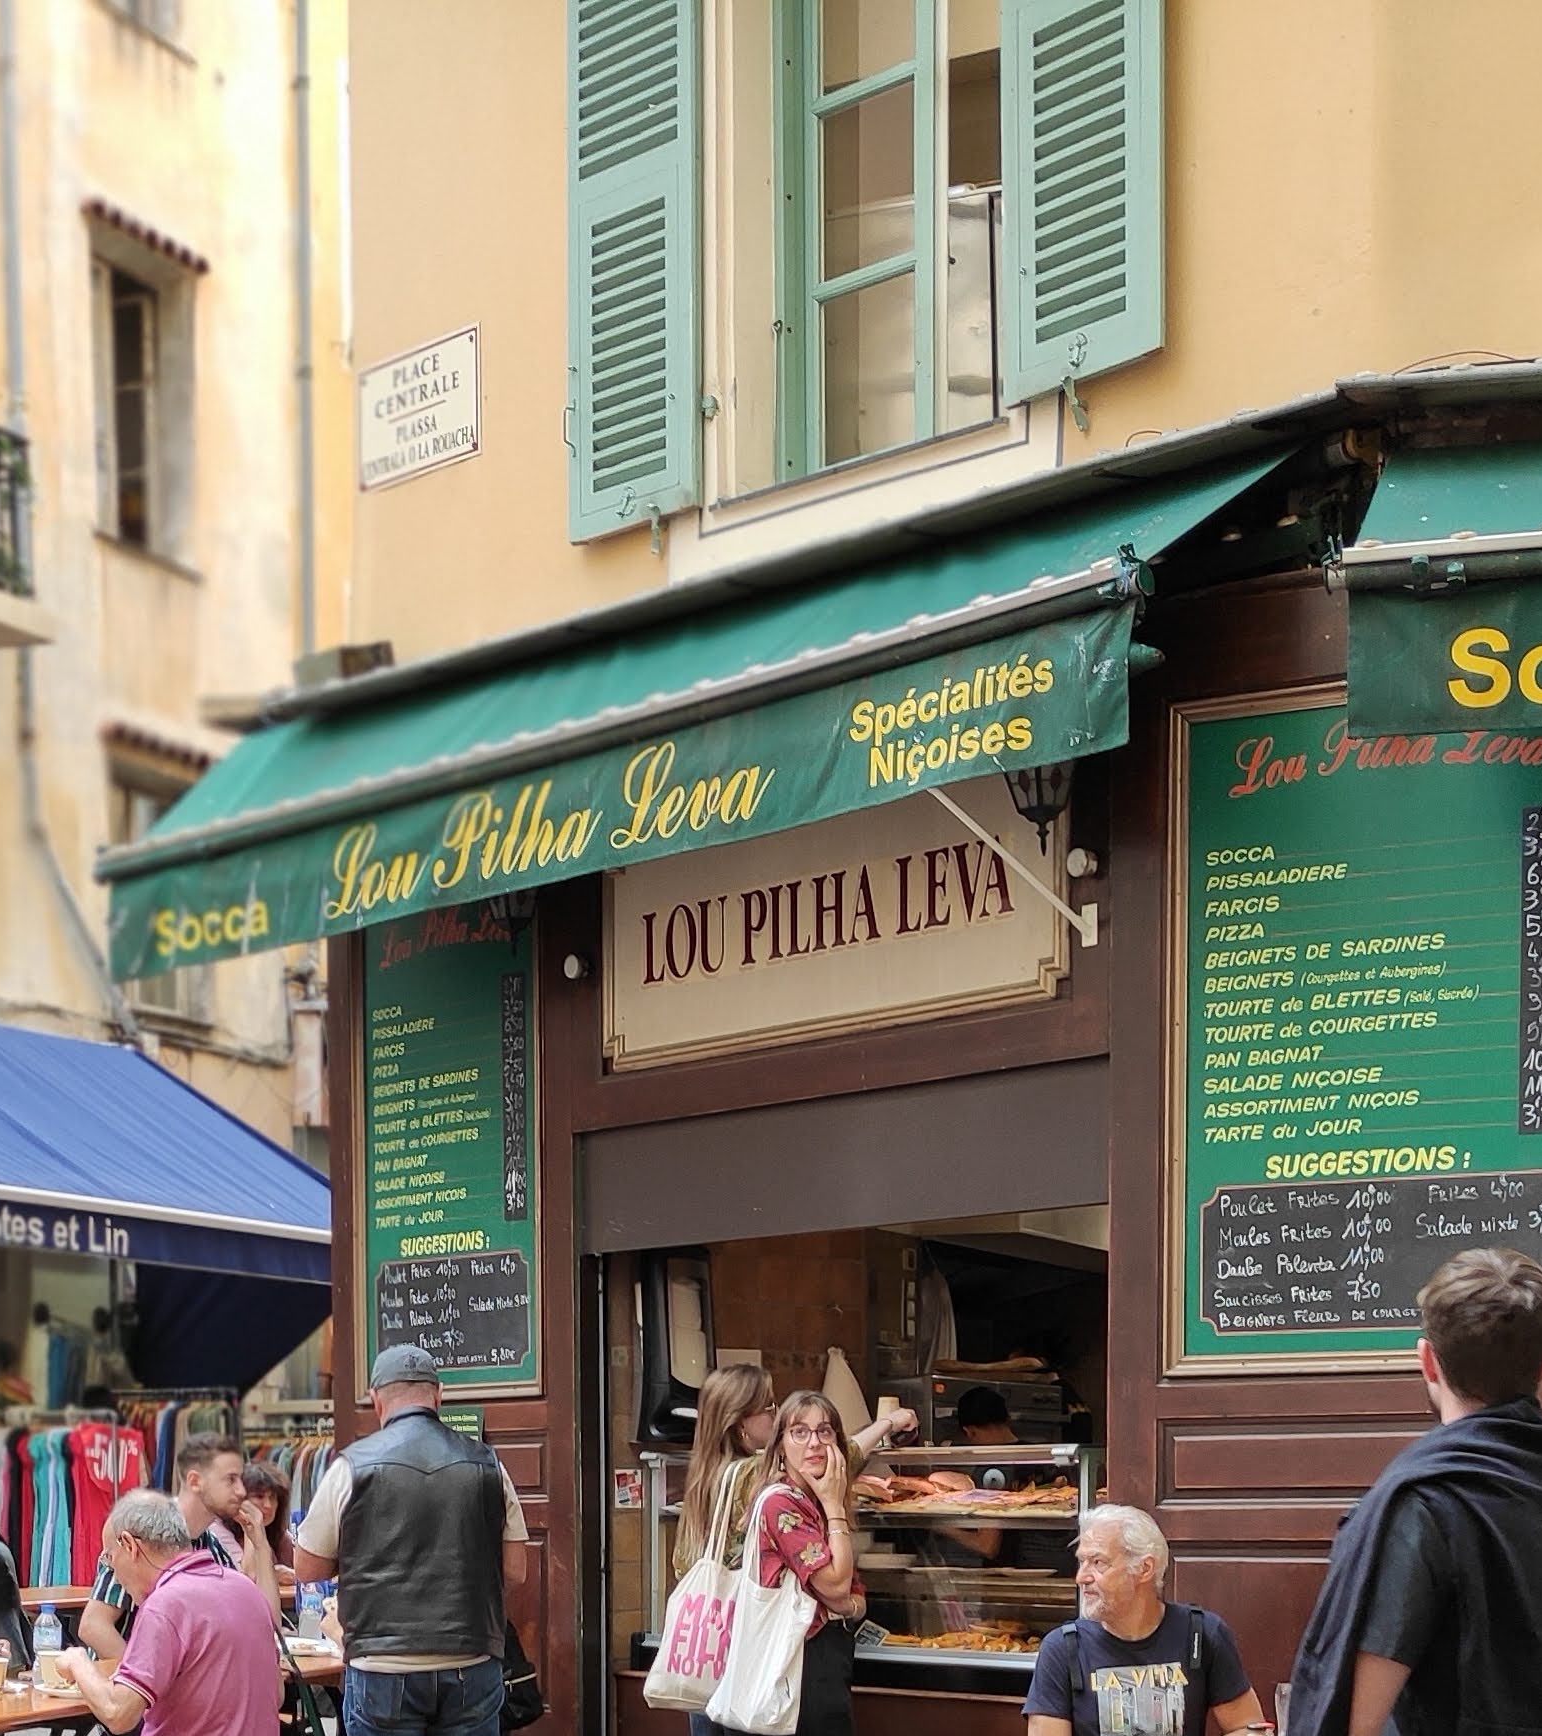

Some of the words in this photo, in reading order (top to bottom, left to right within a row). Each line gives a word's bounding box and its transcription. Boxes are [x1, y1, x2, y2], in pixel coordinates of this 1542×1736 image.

[392, 353, 441, 388] PLACE
[375, 371, 460, 419] CENTRALE
[396, 413, 438, 445] PLASSA
[418, 442, 430, 461] LA
[849, 652, 1055, 747] Spécialités
[868, 716, 1033, 788] Niçoises
[1228, 735, 1307, 798] Lou
[325, 821, 430, 919] Lou
[433, 779, 603, 889] Pilha
[610, 740, 776, 849] Leva
[1206, 845, 1275, 867] SOCCA
[1206, 863, 1348, 892] PISSALADIERE
[641, 895, 728, 985] LOU
[740, 864, 883, 967] PILHA
[894, 834, 1016, 936] LEVA
[1205, 895, 1280, 918] FARCIS
[155, 900, 270, 957] Socca
[1205, 922, 1265, 944] PIZZA
[1205, 946, 1296, 970] BEIGNETS
[1306, 942, 1331, 961] DE
[1341, 933, 1445, 957] SARDINES
[1205, 971, 1294, 994] BEIGNETS
[1365, 970, 1376, 980] et
[372, 1005, 402, 1022] SOCCA
[1205, 996, 1273, 1019] TOURTE
[1280, 996, 1304, 1013] de
[1310, 988, 1401, 1011] BLETTES
[1205, 1024, 1273, 1045] TOURTE
[1279, 1021, 1303, 1038] de
[1308, 1012, 1438, 1036] COURGETTES
[373, 1042, 405, 1060] FARCIS
[1204, 1050, 1240, 1070] PAN
[1246, 1045, 1323, 1067] BAGNAT
[373, 1063, 400, 1079] PIZZA
[373, 1079, 416, 1099] BEIGNETS
[419, 1077, 430, 1090] DE
[433, 1068, 479, 1087] SARDINES
[1203, 1073, 1284, 1095] SALADE
[1291, 1066, 1383, 1089] NIÇOISE
[373, 1099, 416, 1117] BEIGNETS
[1203, 1094, 1341, 1120] ASSORTIMENT
[1347, 1089, 1420, 1110] NIÇOIS
[374, 1119, 406, 1135] TOURTE
[422, 1109, 464, 1128] BLETTES
[1204, 1124, 1265, 1144] TARTE
[1272, 1123, 1297, 1139] du
[1306, 1118, 1362, 1137] JOUR
[374, 1139, 406, 1155] TOURTE
[421, 1127, 479, 1147] COURGETTES
[374, 1160, 390, 1174] PAN
[393, 1154, 428, 1171] BAGNAT
[374, 1177, 406, 1193] SALADE
[375, 1191, 433, 1210] ASSORTIMENT
[1220, 1194, 1277, 1217] Poulet
[375, 1215, 402, 1230] TARTE
[404, 1213, 415, 1226] du
[418, 1209, 445, 1225] JOUR
[1416, 1213, 1472, 1238] Salade
[52, 1215, 80, 1250] et
[88, 1215, 129, 1256] Lin
[1219, 1226, 1271, 1248] Moules
[1217, 1256, 1263, 1279] Daube
[1277, 1253, 1337, 1275] Polenta
[1091, 1671, 1122, 1691] LA
[1131, 1664, 1189, 1688] VITA
